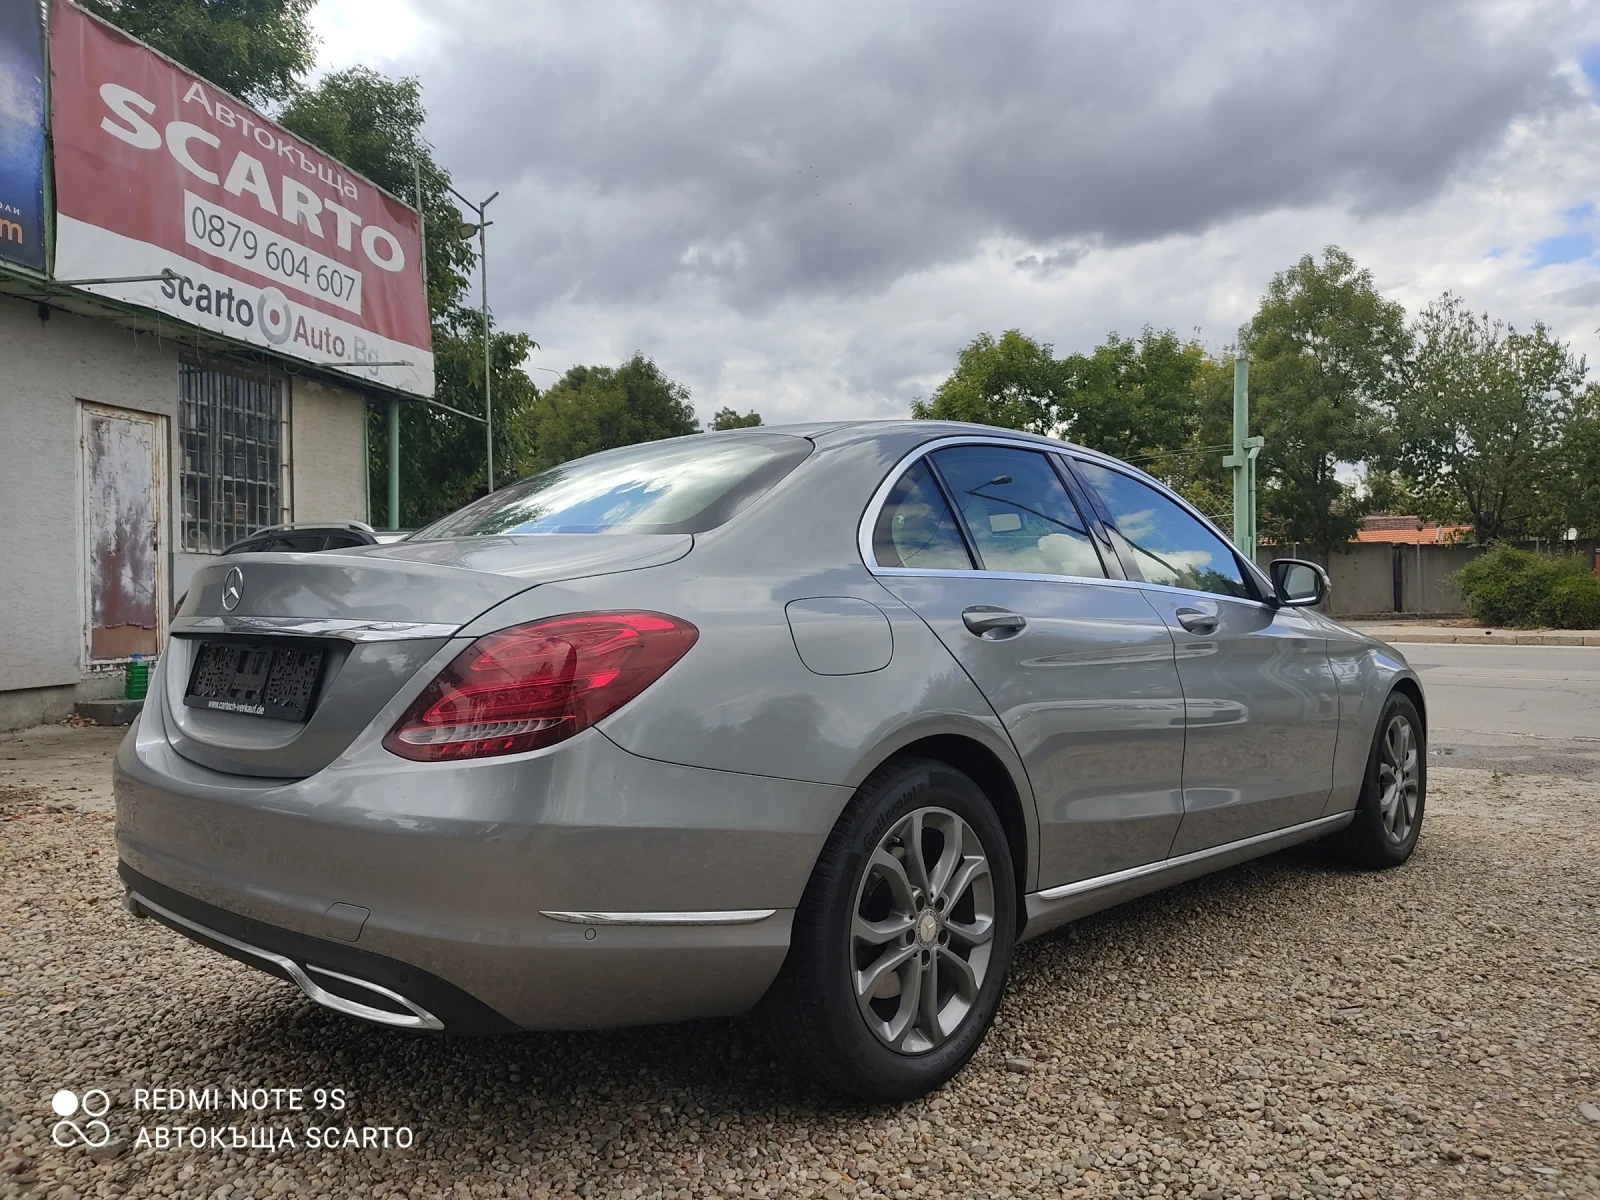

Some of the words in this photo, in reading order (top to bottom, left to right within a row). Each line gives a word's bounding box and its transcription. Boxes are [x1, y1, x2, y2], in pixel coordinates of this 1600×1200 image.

[99, 83, 405, 272] SCARTO
[191, 205, 258, 260] 0879
[265, 241, 310, 285] 604
[316, 264, 356, 302] 607
[208, 700, 265, 715] www.cartech-verkauf.de
